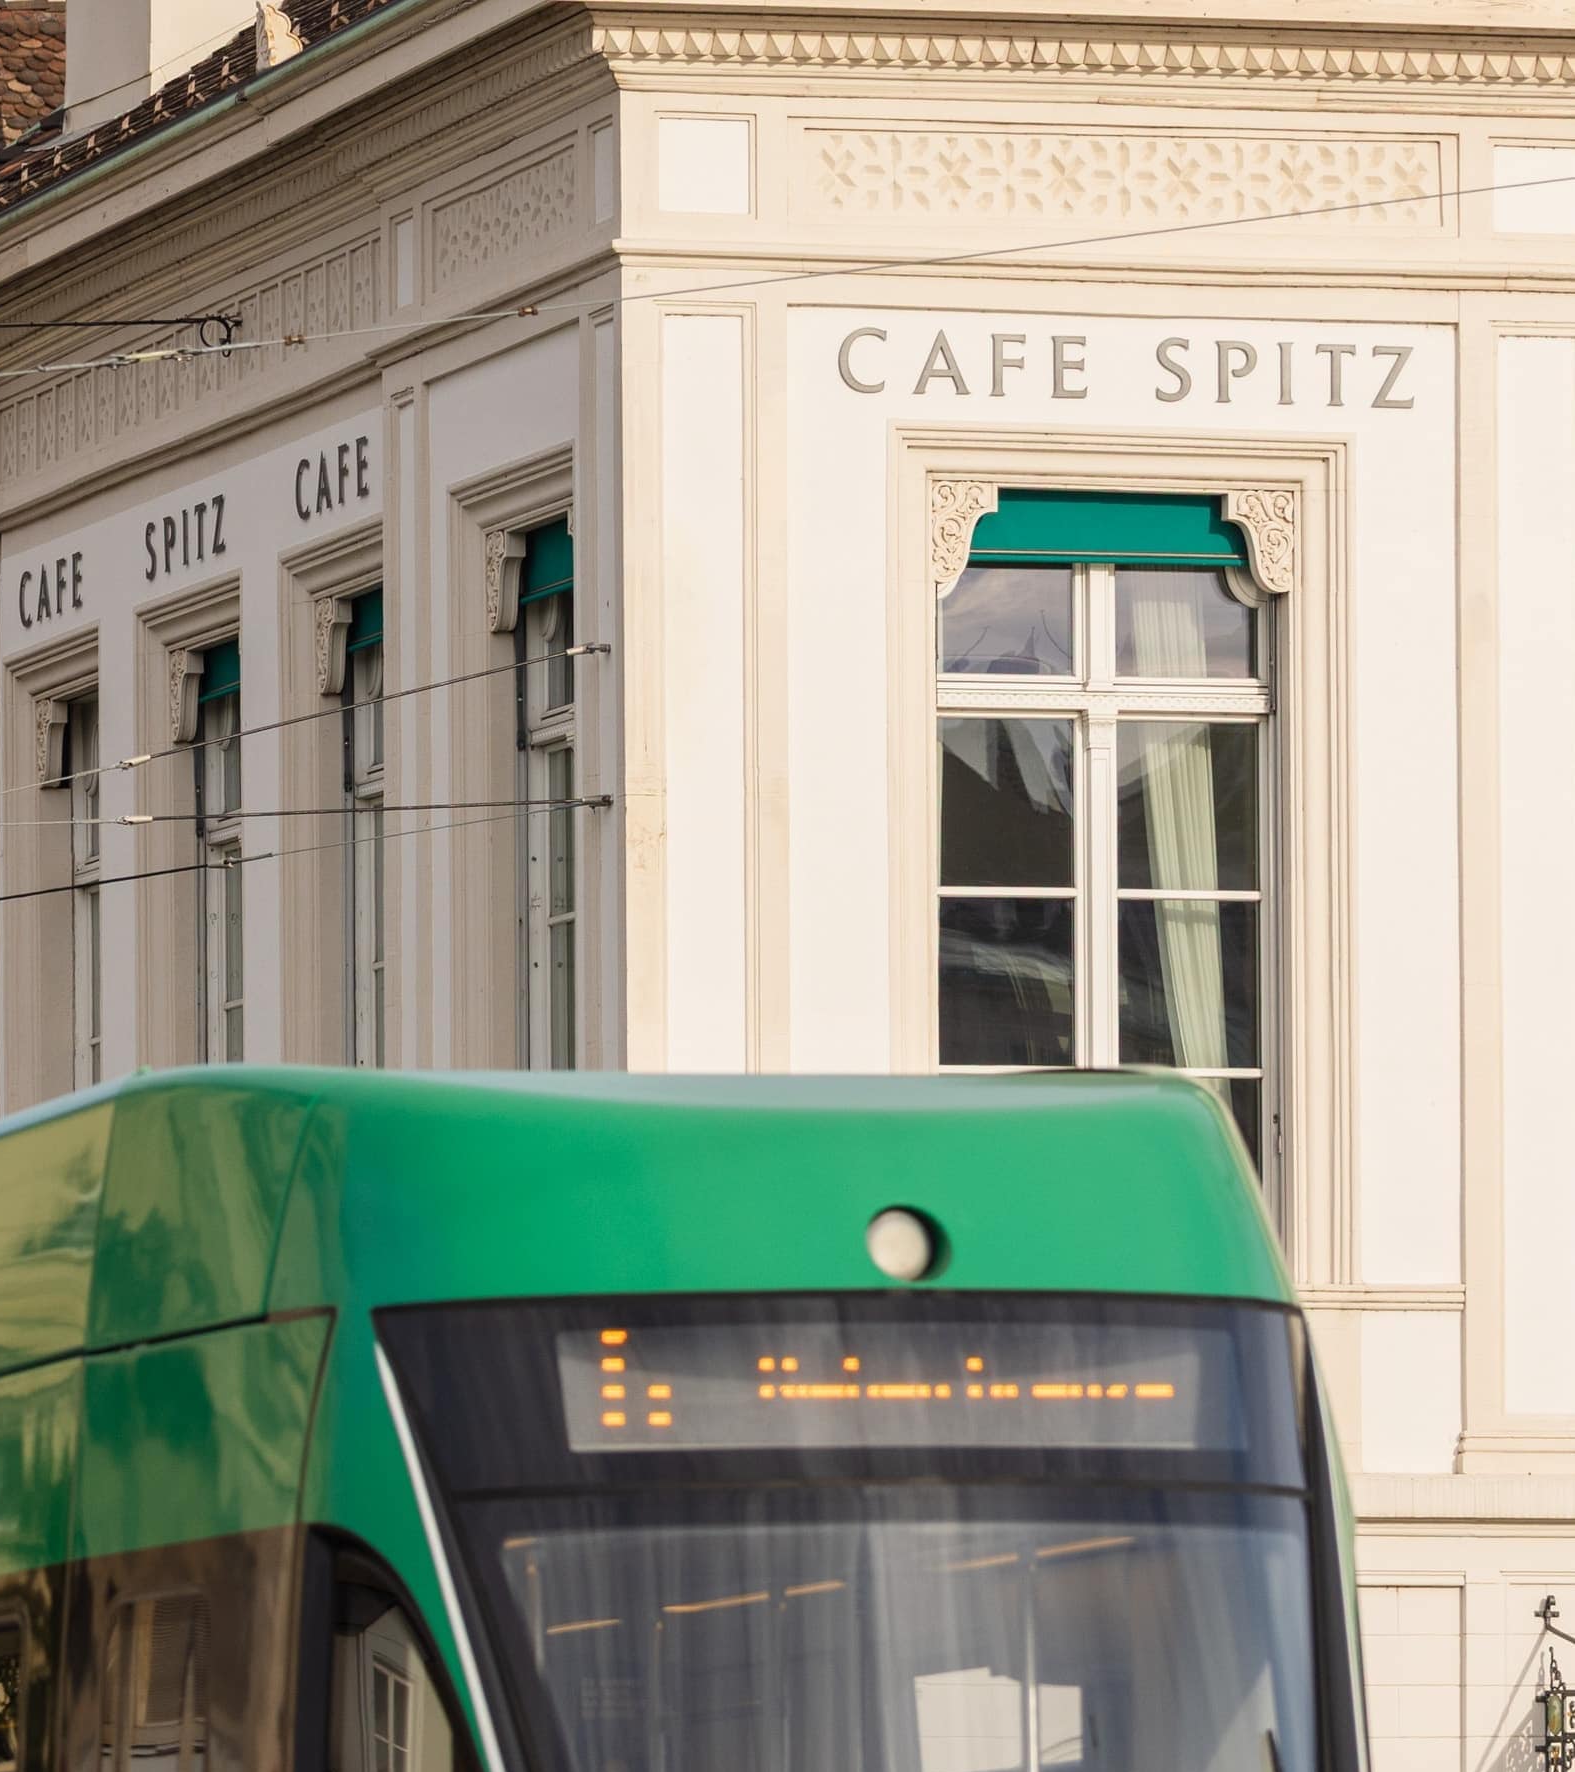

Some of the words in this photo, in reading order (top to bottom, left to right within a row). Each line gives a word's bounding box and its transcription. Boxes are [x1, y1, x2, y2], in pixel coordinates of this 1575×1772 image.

[837, 326, 1088, 399] CAFE
[1154, 337, 1415, 409] SPITZ
[18, 551, 84, 628] CAFE
[144, 494, 227, 581] SPITZ
[295, 435, 369, 521] CAFE
